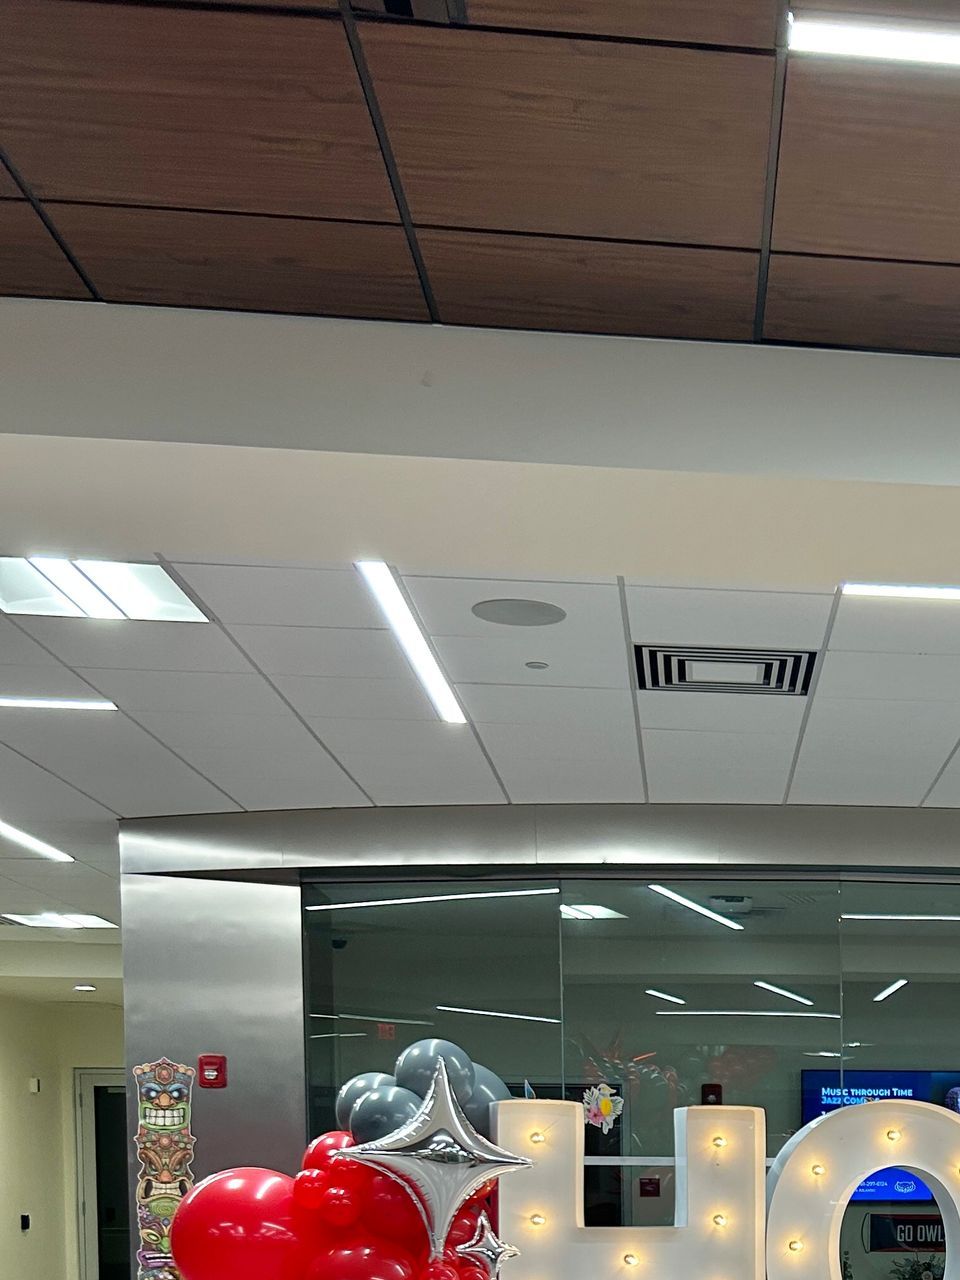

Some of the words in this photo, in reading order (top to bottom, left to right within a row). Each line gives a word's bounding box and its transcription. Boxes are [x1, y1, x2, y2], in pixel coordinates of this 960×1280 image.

[822, 1087, 849, 1096] MUSC
[897, 1225, 913, 1241] GO
[917, 1225, 945, 1241] OWL
